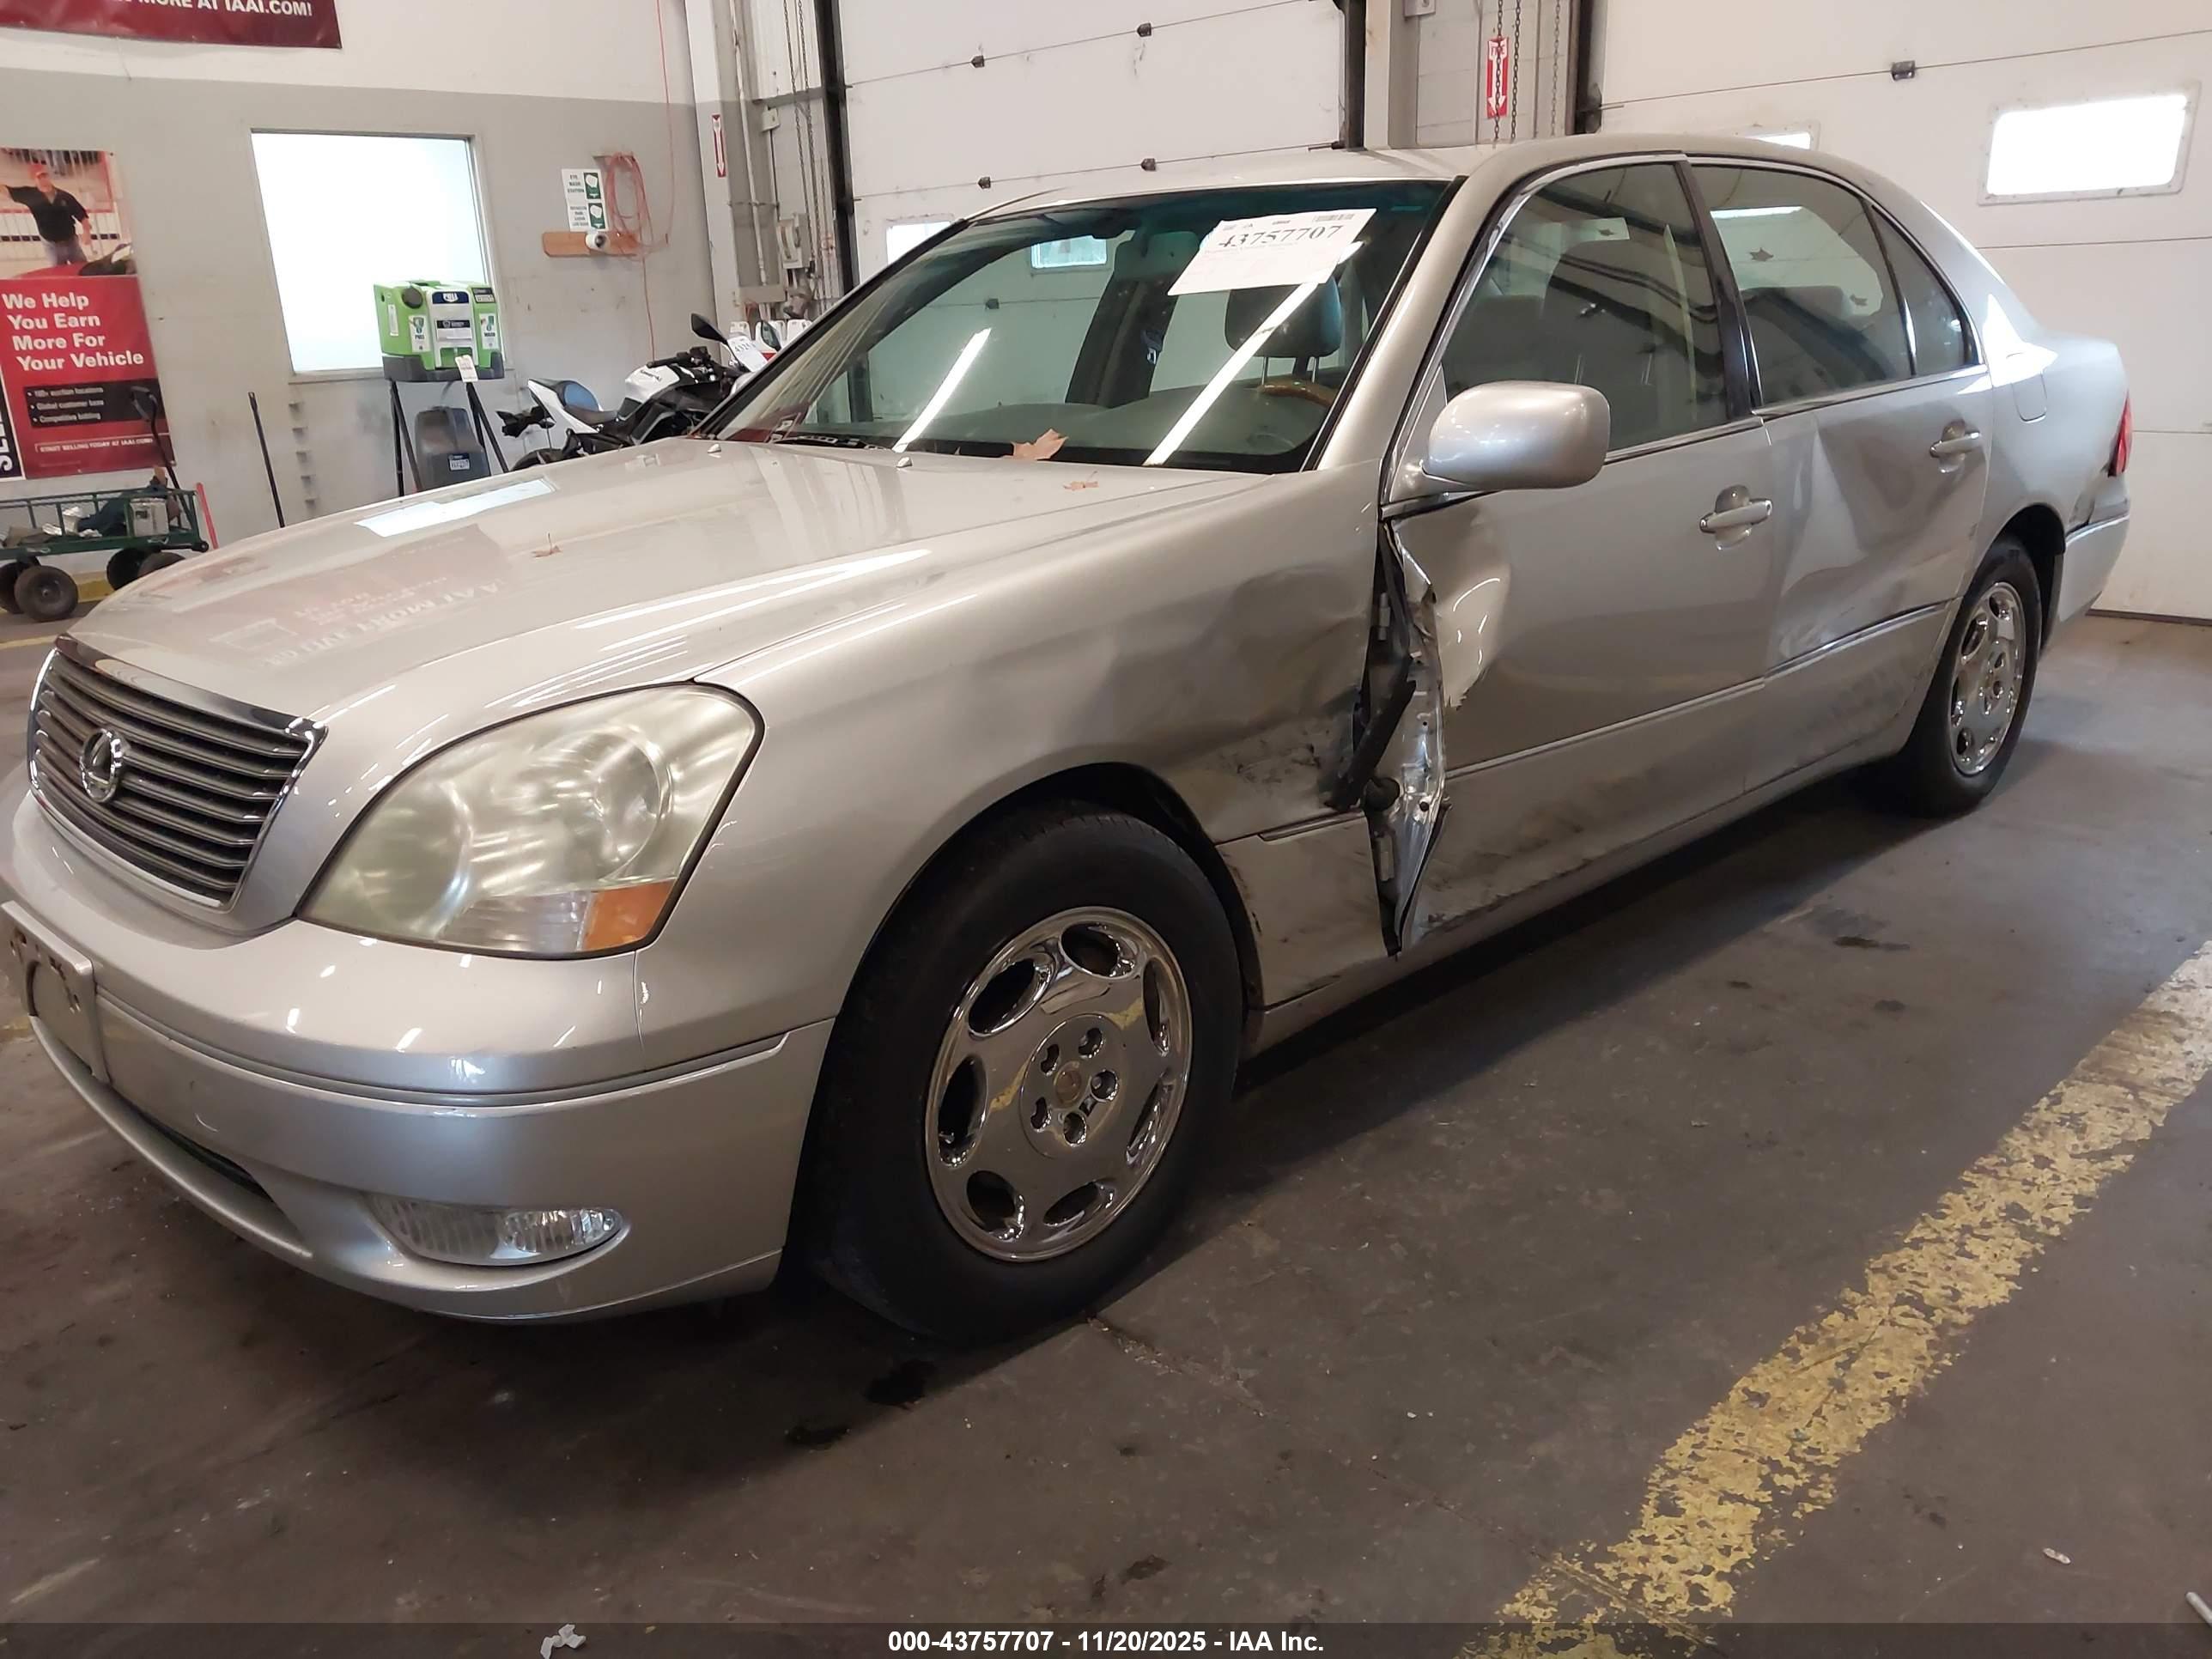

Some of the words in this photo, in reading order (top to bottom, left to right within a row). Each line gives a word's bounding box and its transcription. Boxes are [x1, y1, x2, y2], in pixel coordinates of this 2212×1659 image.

[1218, 224, 1345, 248] 43757707
[2, 293, 36, 309] We
[41, 292, 89, 310] Help
[7, 314, 48, 331] You
[53, 313, 101, 329] Earn
[12, 335, 67, 351] More
[72, 332, 106, 348] For
[16, 355, 65, 371] Your
[70, 350, 144, 368] Vehicle
